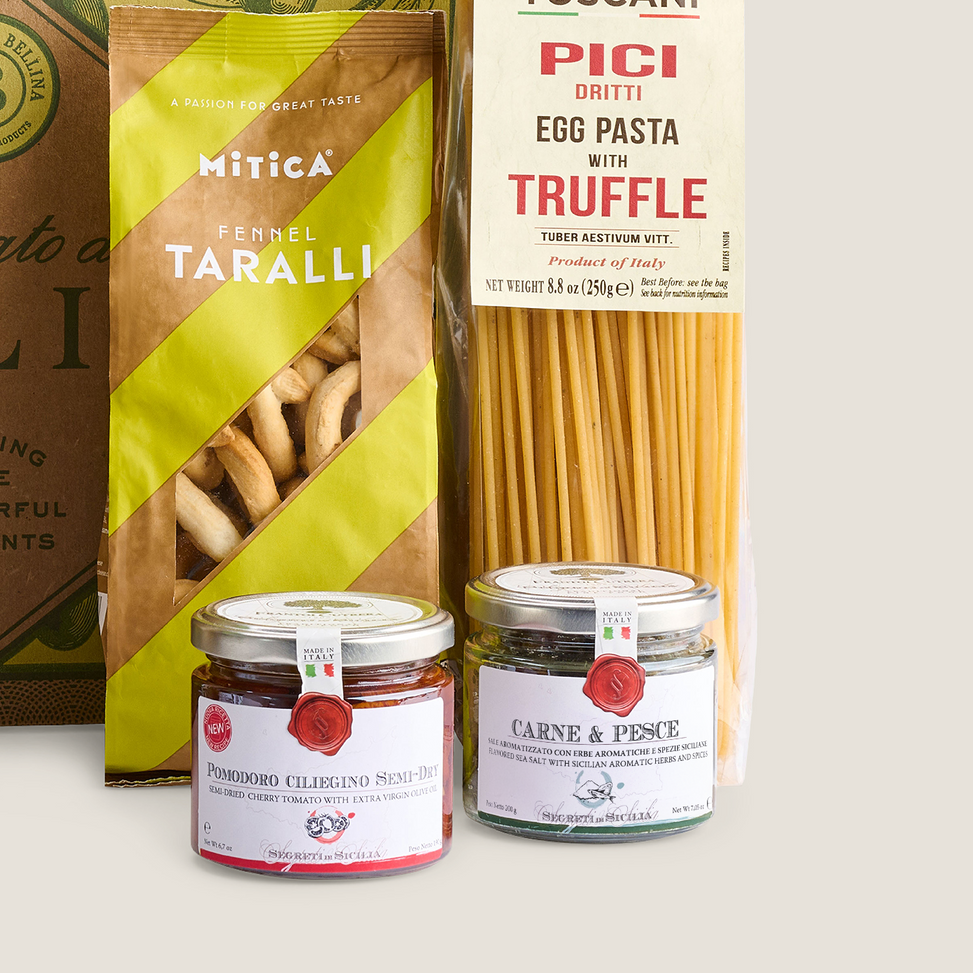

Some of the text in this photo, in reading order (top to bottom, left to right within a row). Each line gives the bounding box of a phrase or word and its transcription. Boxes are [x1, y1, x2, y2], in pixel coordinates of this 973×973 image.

[3, 34, 45, 102] BELLINA
[540, 41, 677, 79] PICI
[575, 83, 642, 101] DRITTI
[171, 94, 361, 111] A PASSION FOR GREAT TASTE
[536, 115, 680, 145] EGG PASTA
[588, 153, 628, 168] WITH
[507, 173, 708, 220] TRUFFLE
[218, 225, 317, 242] FENNEL
[541, 231, 673, 245] TUBER AESTIVUM VITT.
[165, 244, 372, 284] TARALLI
[548, 255, 666, 271] Product of Italy
[208, 723, 225, 735] NEW
[511, 718, 679, 743] CARNE & PESCE
[517, 754, 528, 763] SEA
[529, 756, 546, 765] SALT
[548, 758, 570, 766] WITH
[571, 759, 607, 768] SICILIAN
[609, 757, 653, 767] AROMATIC
[654, 755, 676, 764] HERBS
[677, 753, 691, 762] AND
[692, 750, 708, 760] SPICES
[207, 762, 439, 788] POMODORO CILIEGINO SEMI-DRY
[209, 787, 438, 804] SEMI-DRIED CHERRY TOMATO WITH EXTRA VIRGIN OLIVE OIL
